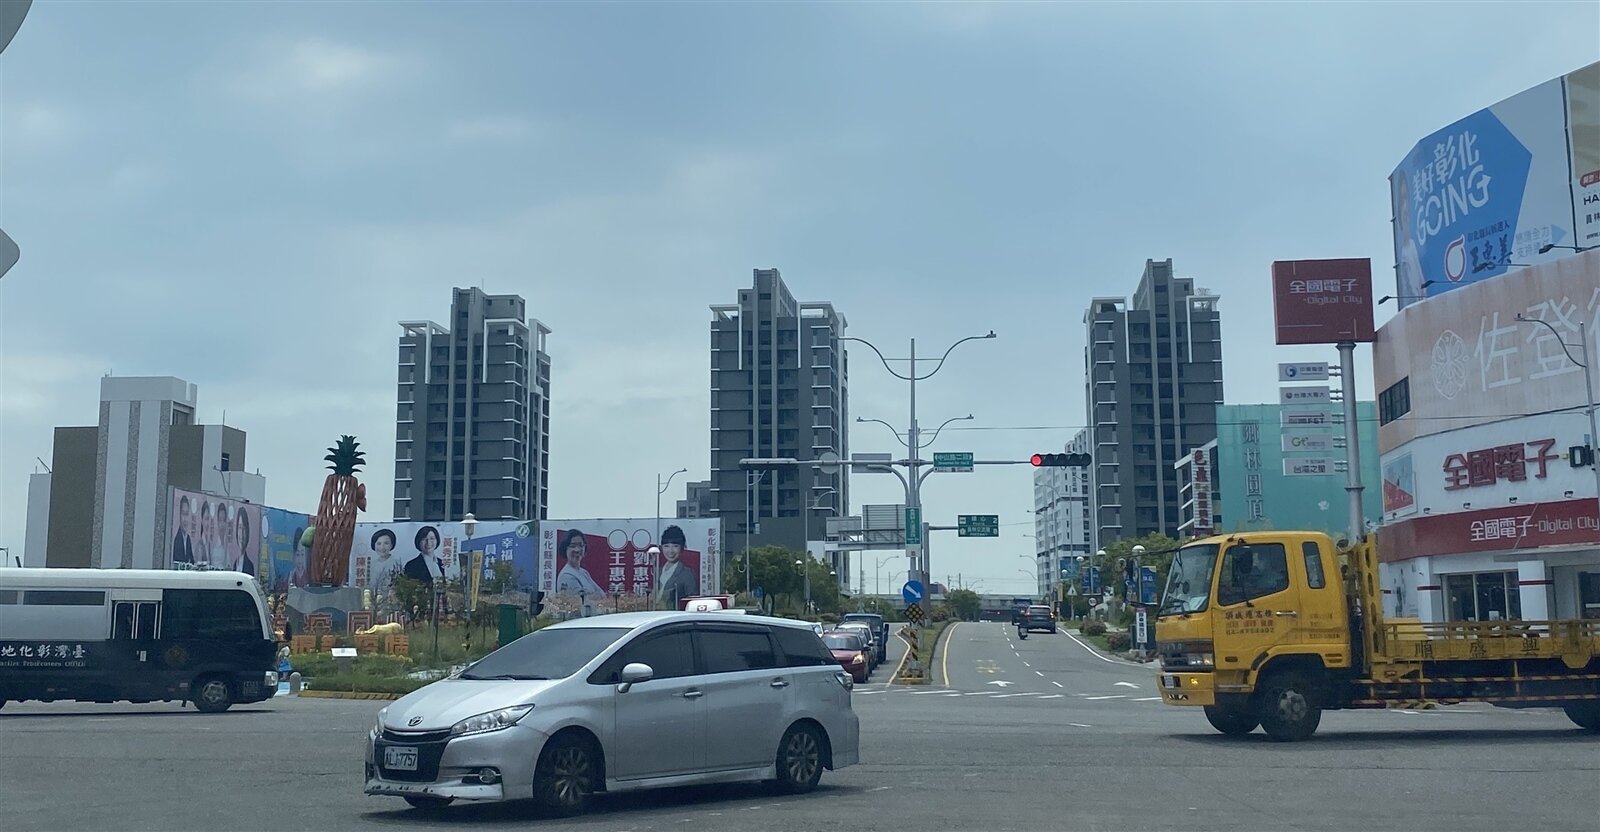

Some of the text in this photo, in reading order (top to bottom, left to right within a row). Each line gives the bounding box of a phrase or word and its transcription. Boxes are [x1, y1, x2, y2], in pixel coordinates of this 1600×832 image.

[1413, 131, 1479, 210] 美好彰化
[1416, 164, 1491, 246] GOING
[1583, 193, 1600, 206] HA
[1289, 278, 1358, 294] 全國電子
[1443, 438, 1559, 491] 全國電子
[1470, 515, 1534, 541] 全國電子
